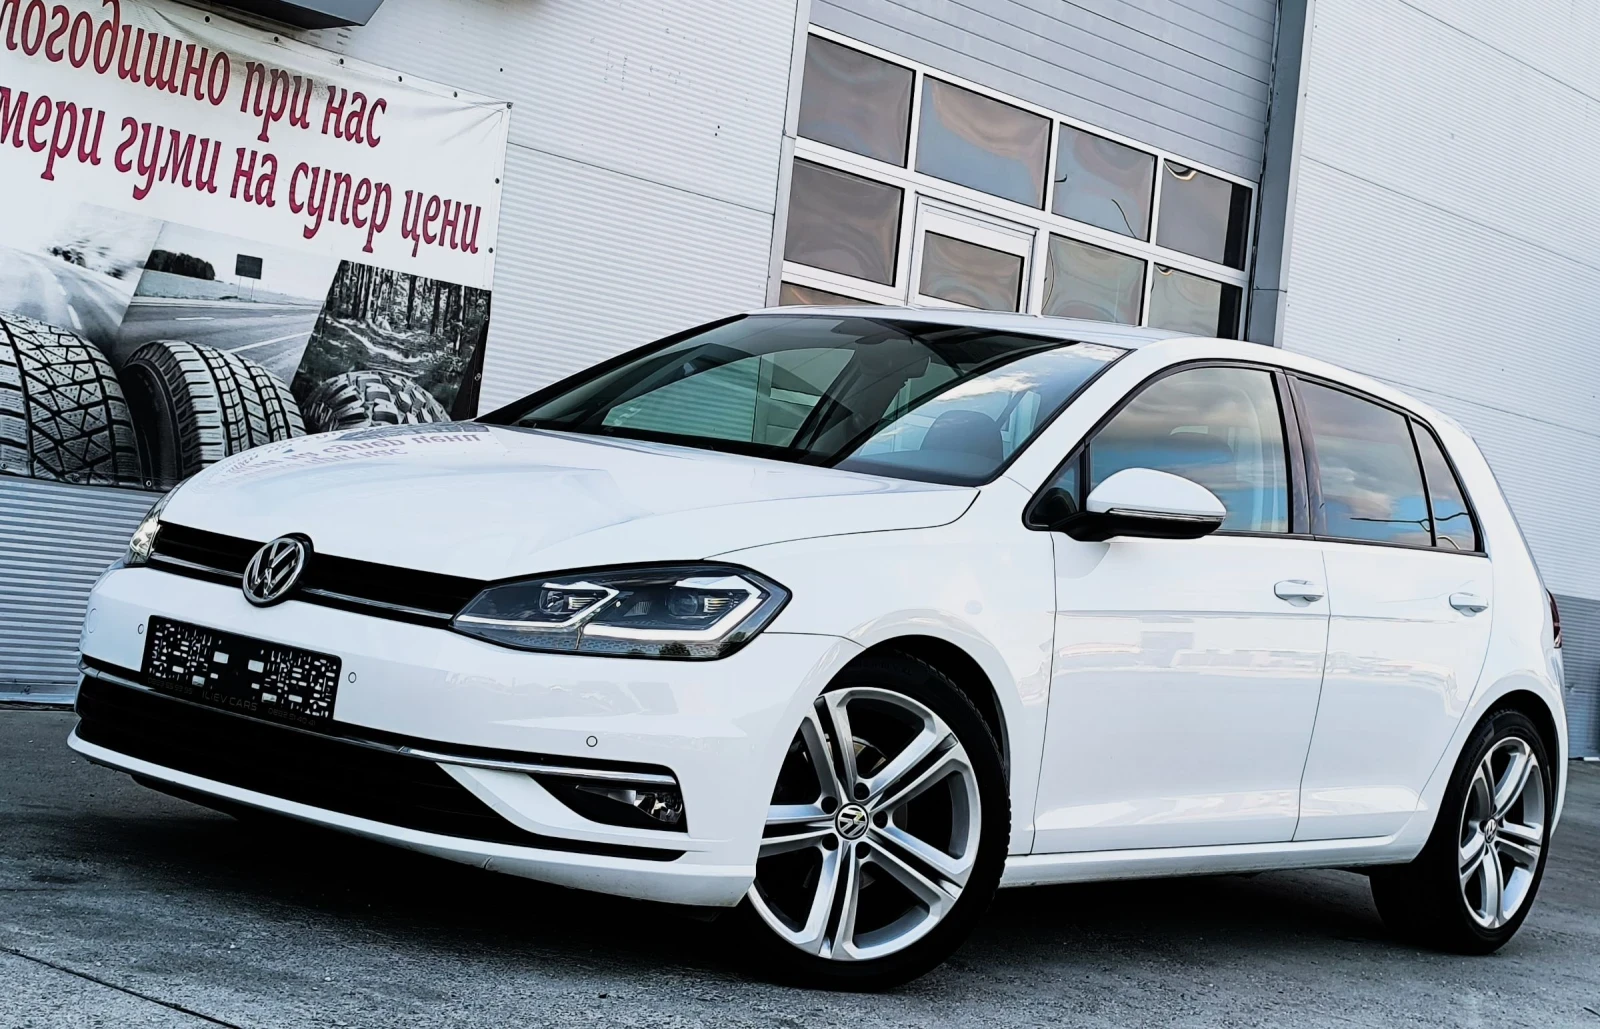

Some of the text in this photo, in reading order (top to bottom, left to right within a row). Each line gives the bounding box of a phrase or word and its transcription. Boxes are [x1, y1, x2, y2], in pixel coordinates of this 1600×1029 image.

[239, 61, 312, 143] при
[321, 84, 388, 149] нас
[0, 86, 482, 258] мери гуми на супер цени
[228, 696, 258, 712] CARS
